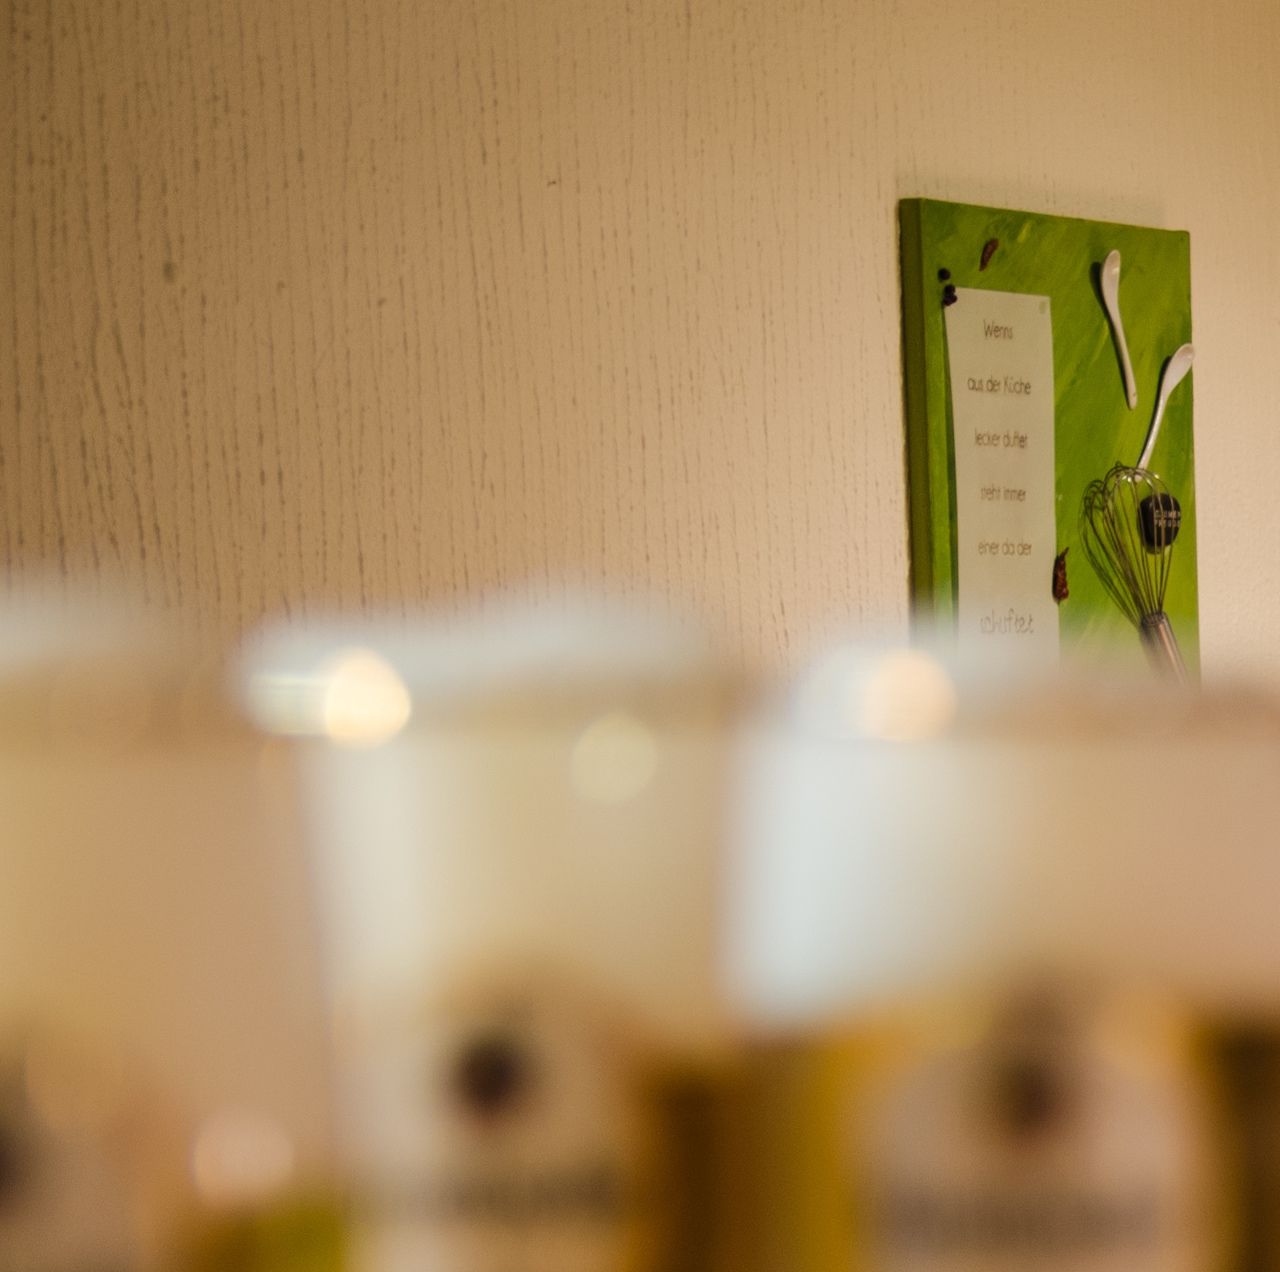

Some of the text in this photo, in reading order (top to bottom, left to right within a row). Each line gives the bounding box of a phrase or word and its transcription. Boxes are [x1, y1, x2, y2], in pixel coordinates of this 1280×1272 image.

[983, 319, 1014, 340] Wenns
[967, 373, 1032, 396] aus der Küche
